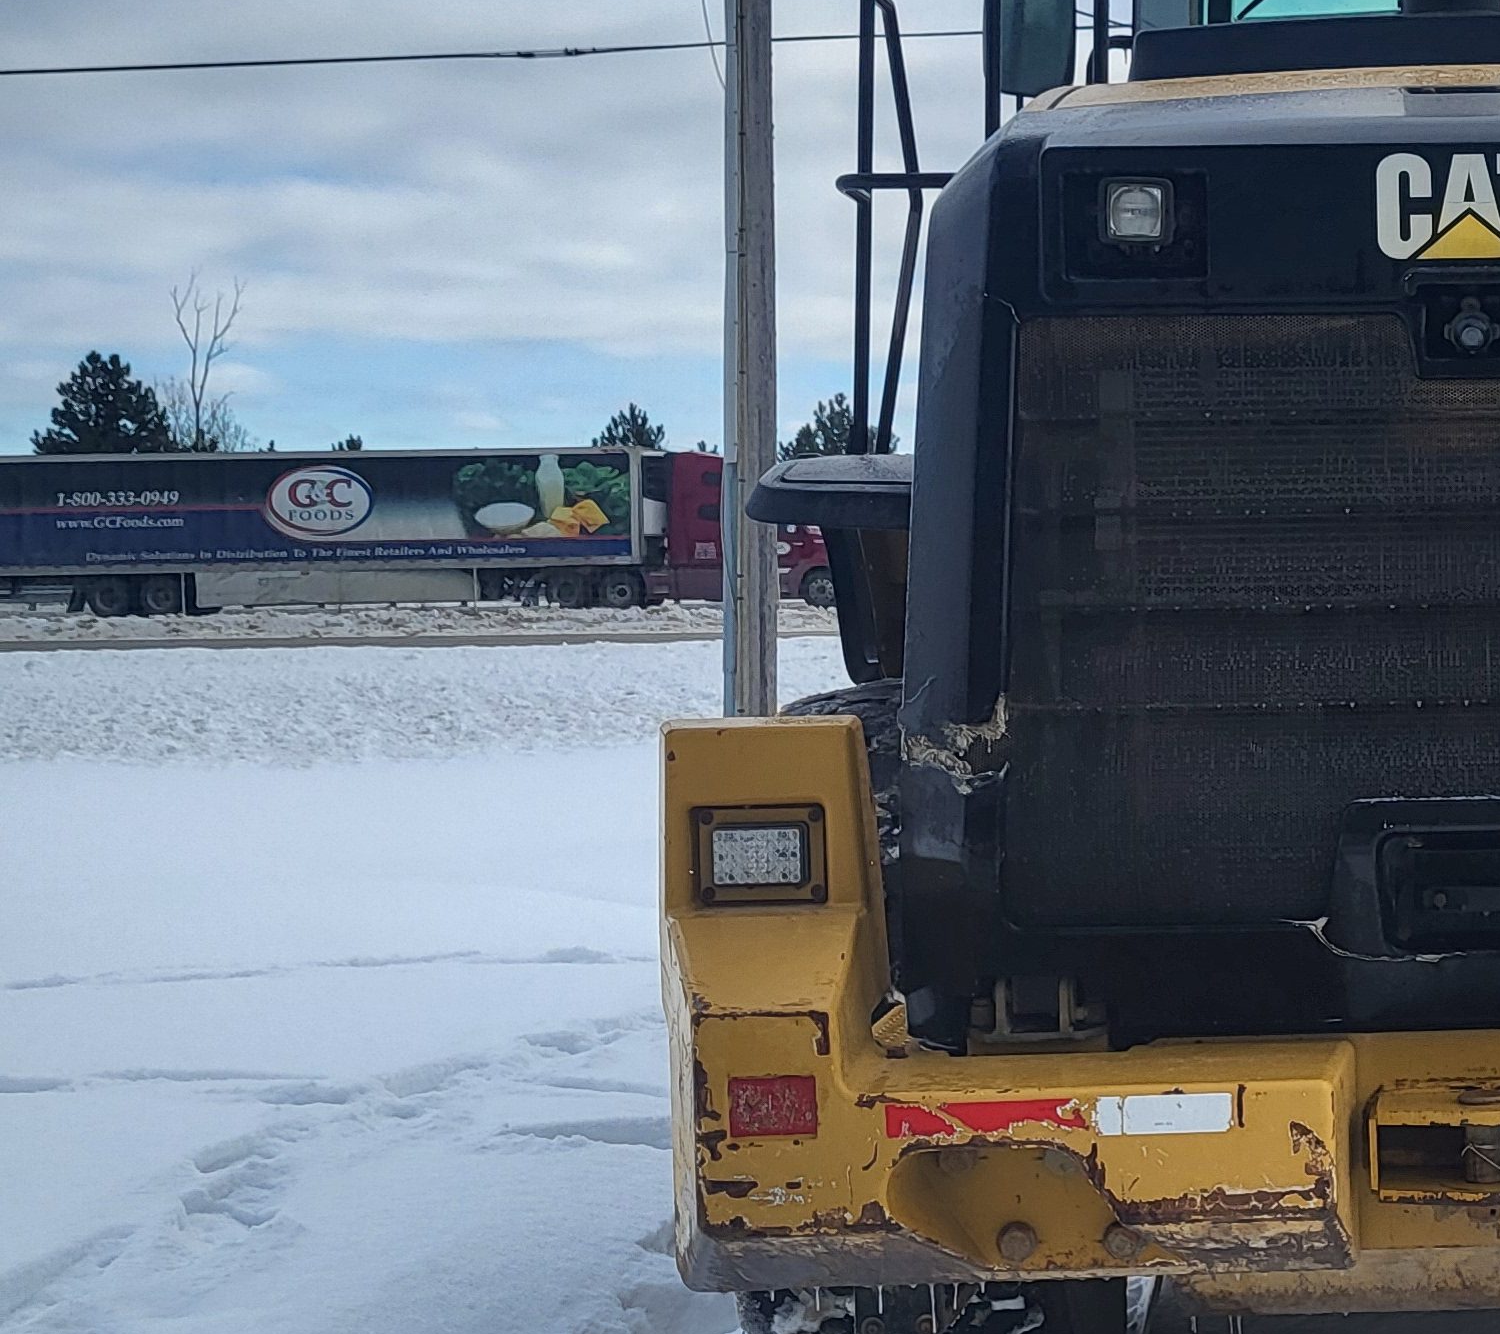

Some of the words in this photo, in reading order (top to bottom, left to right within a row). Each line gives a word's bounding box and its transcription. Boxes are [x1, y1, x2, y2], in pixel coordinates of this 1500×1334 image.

[57, 490, 180, 507] 1-800-333-0949
[288, 478, 353, 508] G&C
[56, 515, 184, 528] www.GCFoods.com
[288, 510, 354, 521] FOODS
